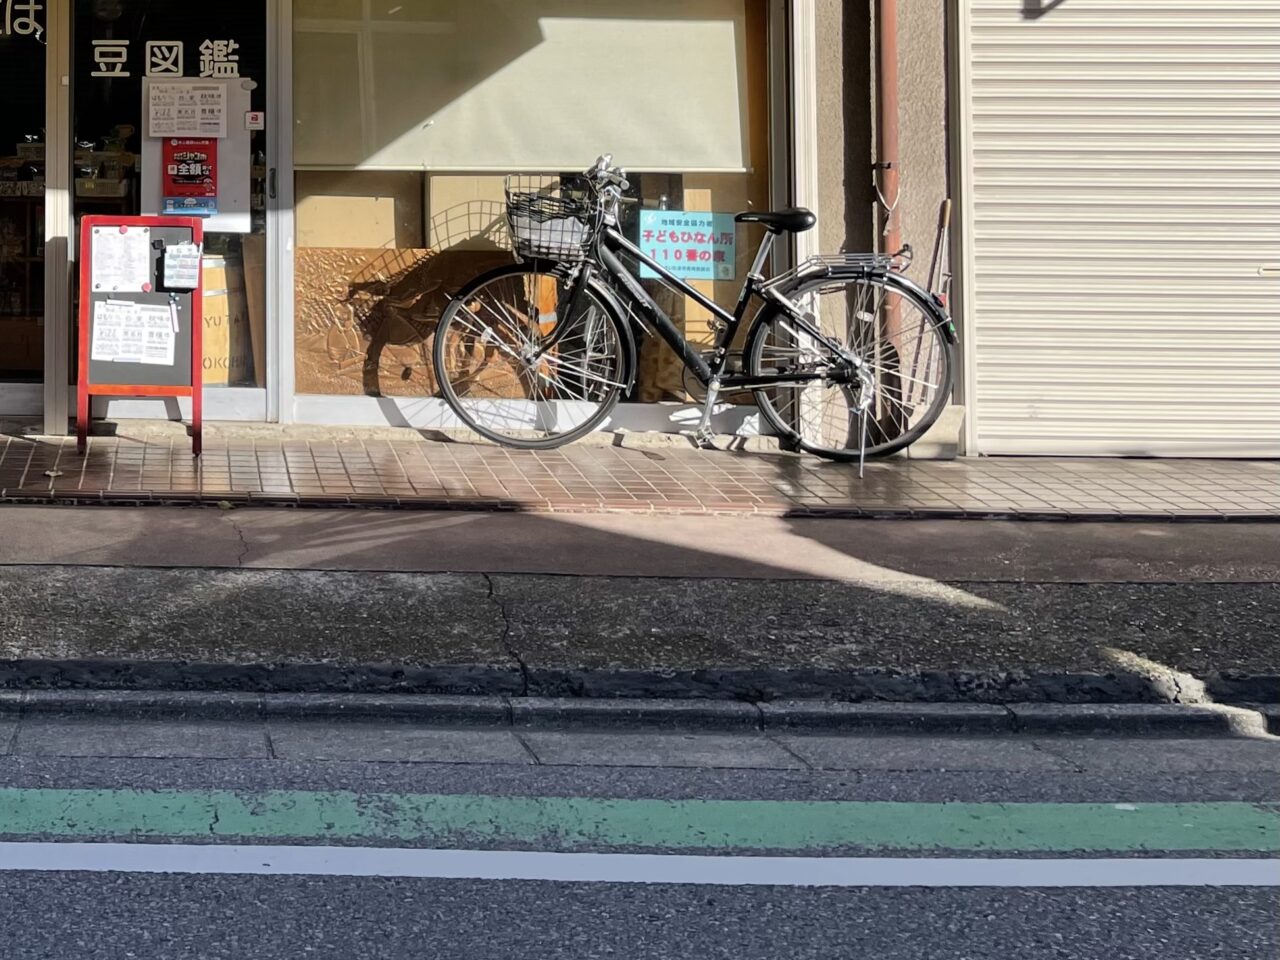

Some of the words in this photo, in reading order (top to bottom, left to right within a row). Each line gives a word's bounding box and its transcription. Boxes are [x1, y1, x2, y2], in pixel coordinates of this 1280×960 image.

[91, 39, 240, 79] 豆図鑑
[642, 230, 734, 246] 子どもひなん所
